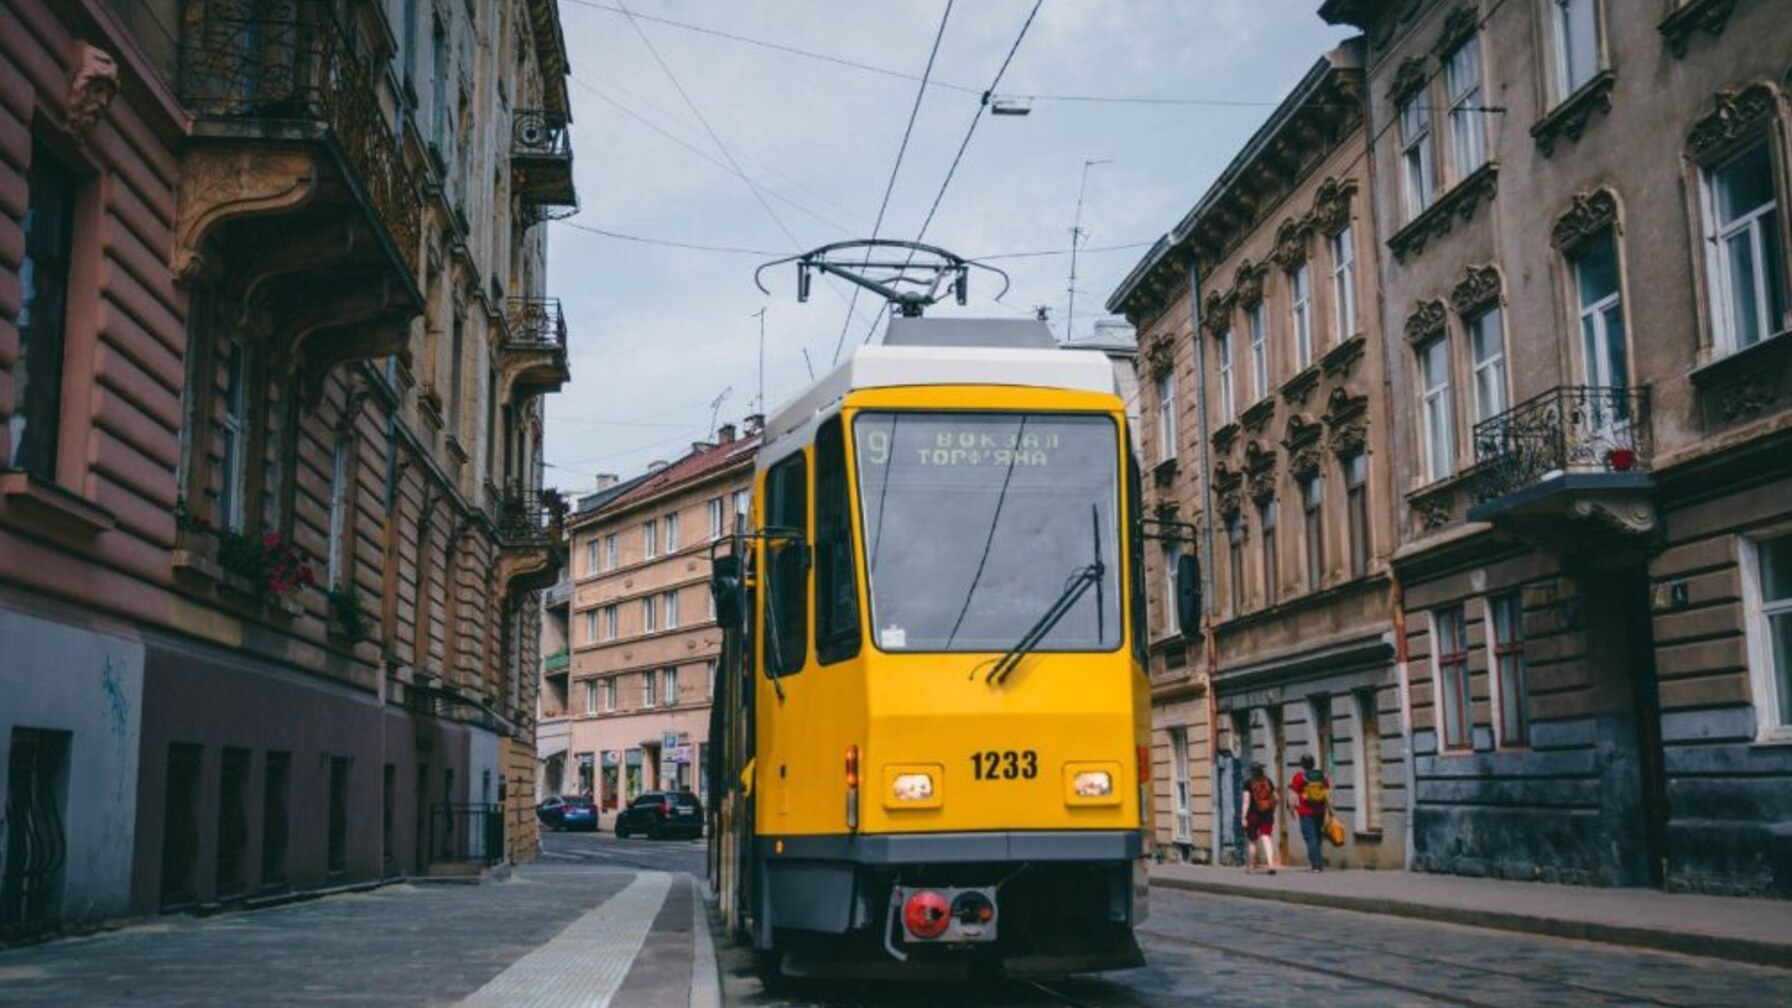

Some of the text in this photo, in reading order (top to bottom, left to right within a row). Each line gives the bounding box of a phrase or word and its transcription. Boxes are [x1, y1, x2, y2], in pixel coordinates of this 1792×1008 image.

[868, 430, 888, 465] 9
[936, 432, 1060, 448] ВОКЗАЛ
[970, 750, 1038, 781] 1233
